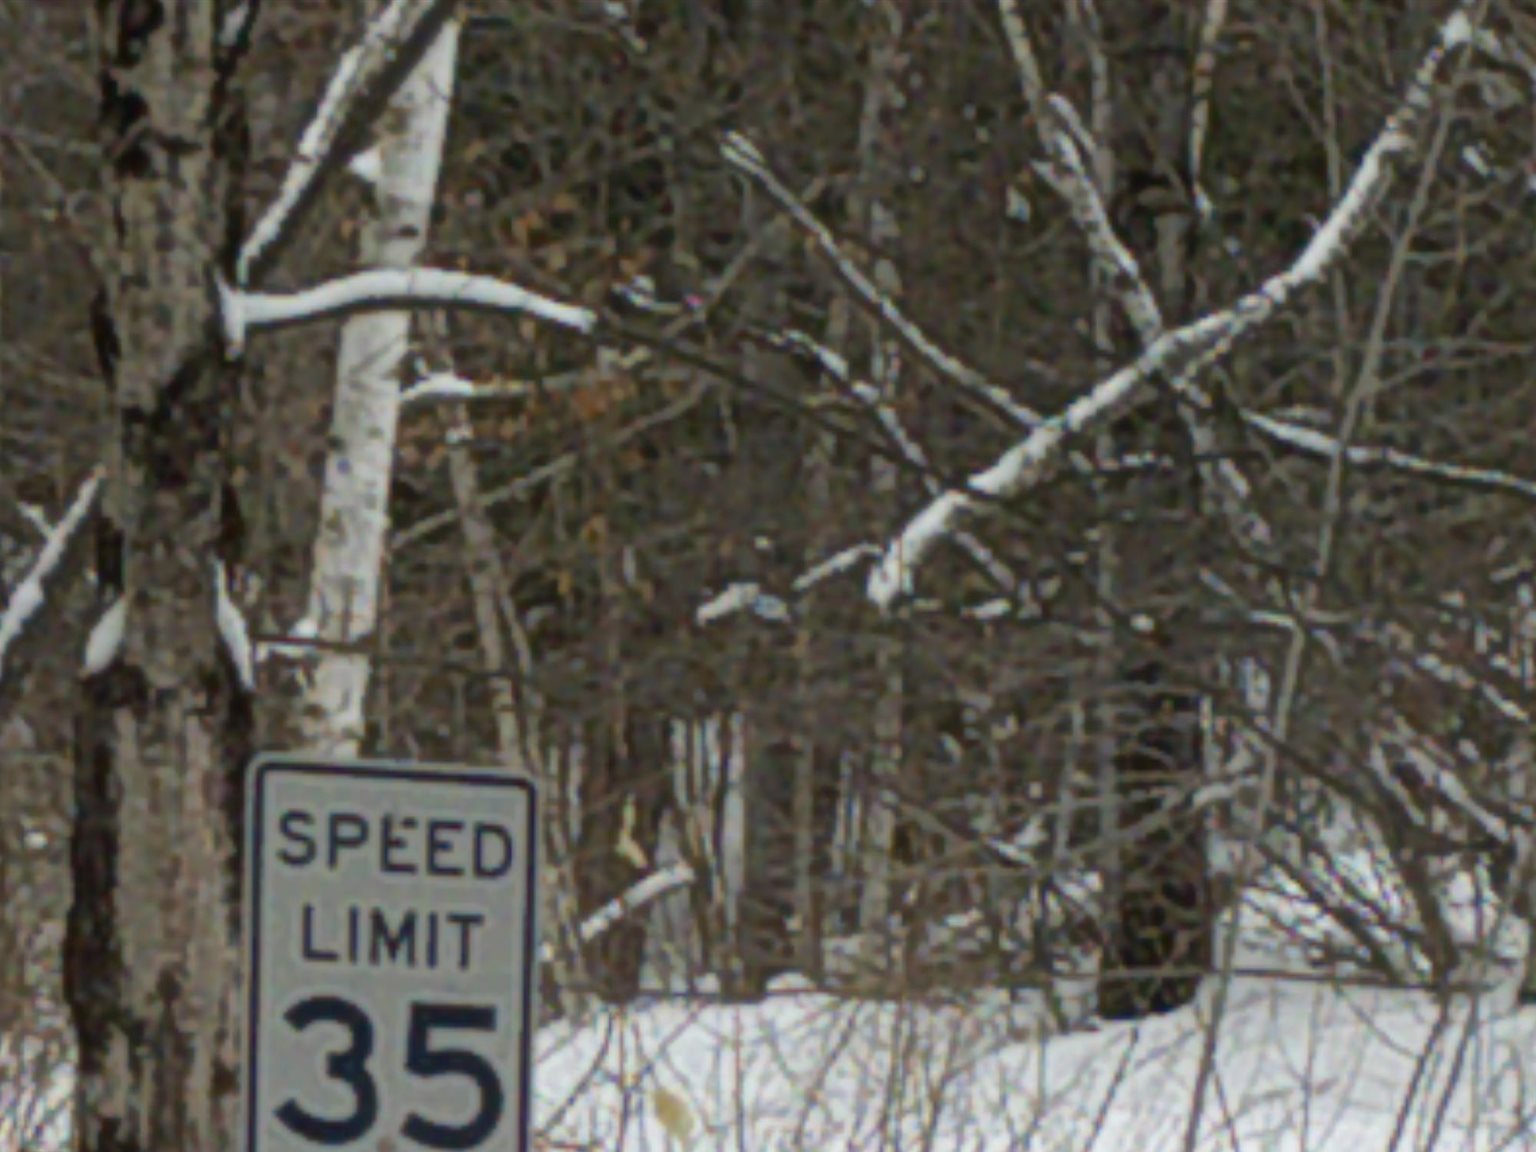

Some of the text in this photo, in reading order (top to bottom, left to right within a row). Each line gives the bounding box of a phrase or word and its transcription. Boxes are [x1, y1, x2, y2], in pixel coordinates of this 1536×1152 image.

[277, 810, 514, 879] SPEED
[302, 904, 485, 970] LIMIT
[275, 996, 504, 1151] 35
